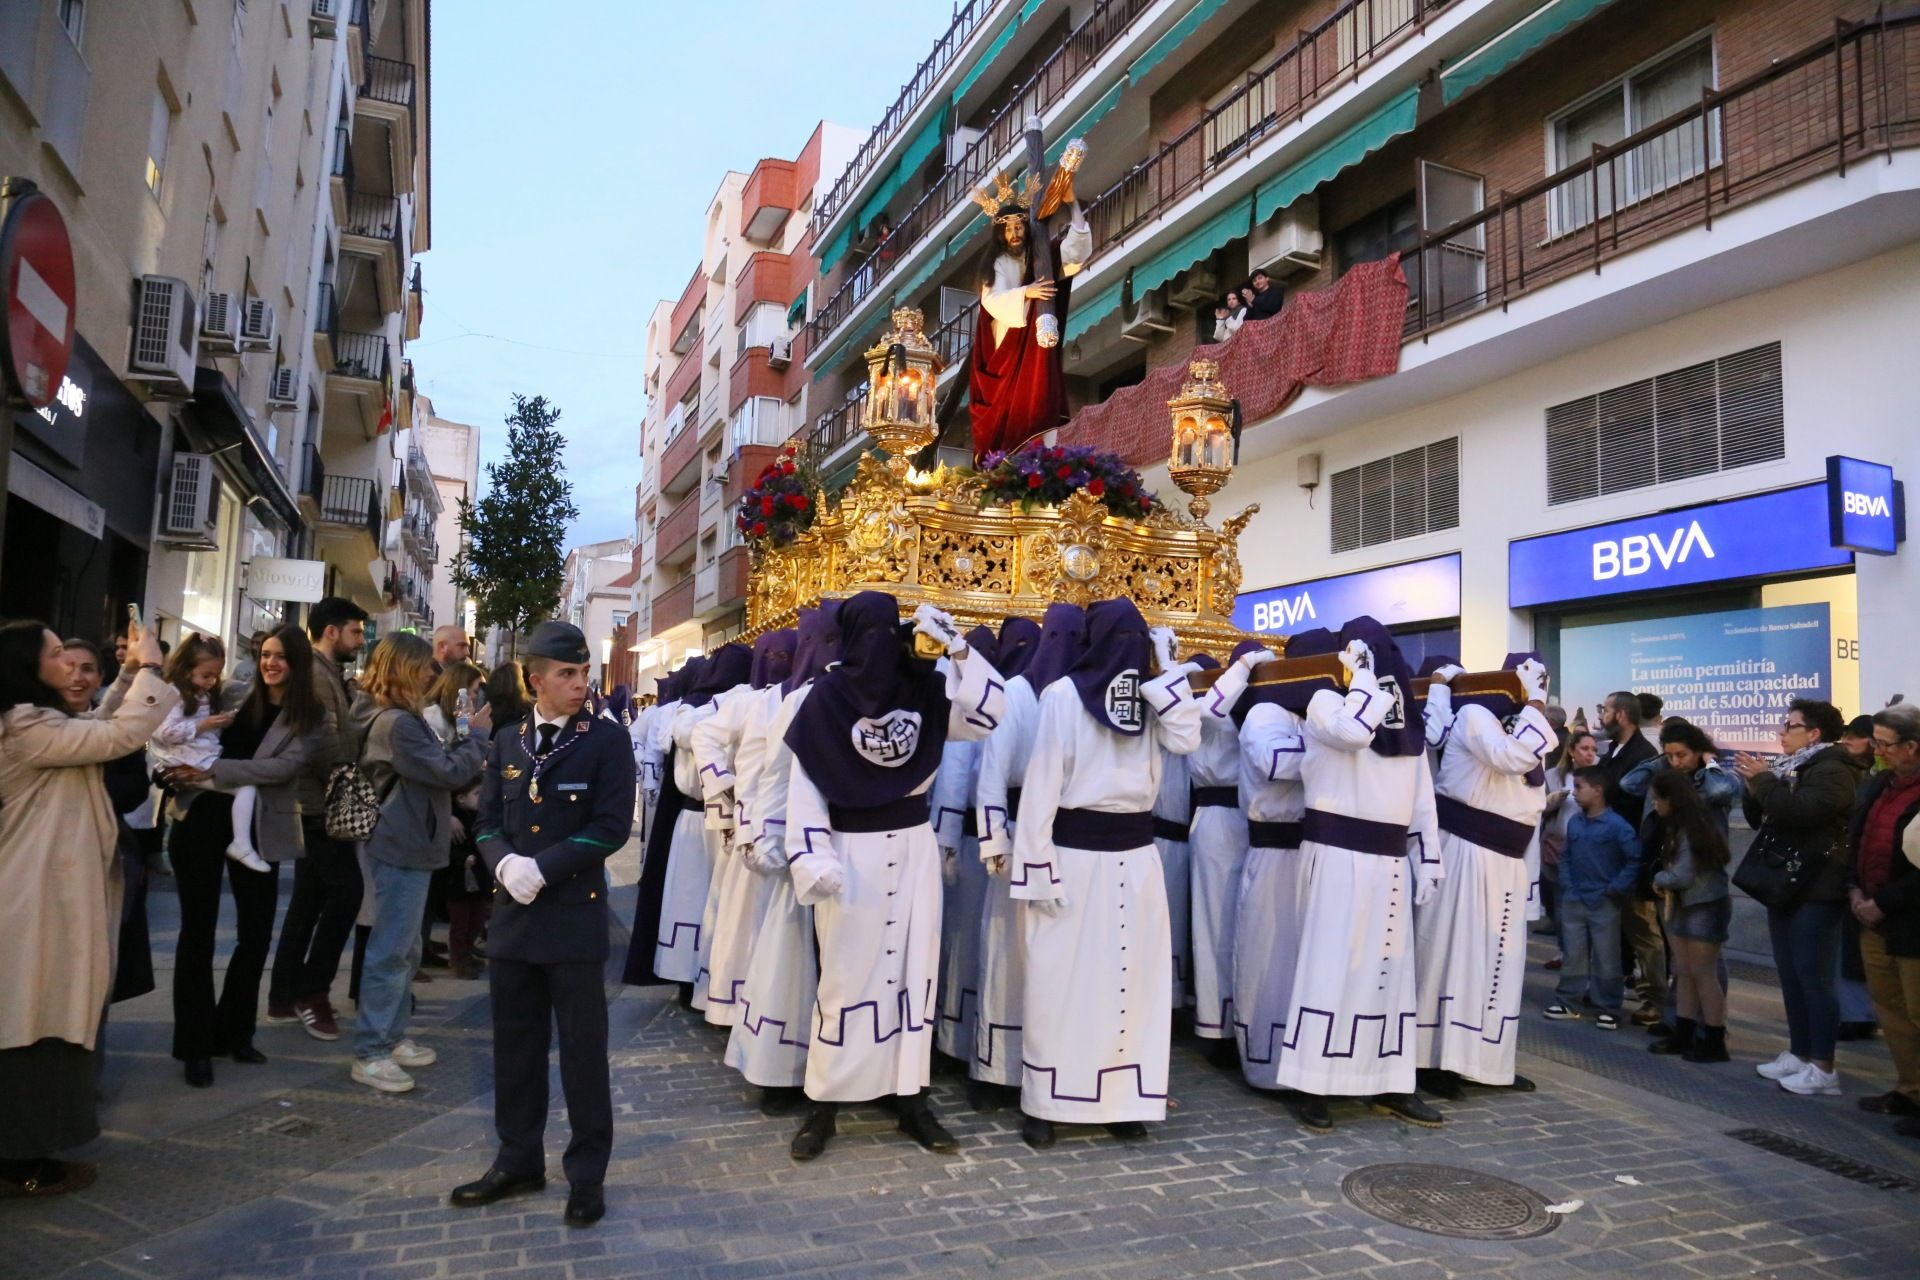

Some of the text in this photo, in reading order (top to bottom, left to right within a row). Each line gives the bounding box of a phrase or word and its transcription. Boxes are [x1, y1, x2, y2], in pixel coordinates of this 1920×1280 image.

[1844, 491, 1890, 517] BBVA
[1592, 520, 1715, 581] BBVA
[1253, 591, 1317, 632] BBVA
[1769, 623, 1790, 631] Banco
[1631, 667, 1649, 682] La
[1651, 664, 1694, 680] unión
[1695, 658, 1776, 681] permitiría
[1677, 682, 1704, 695] con
[1706, 680, 1735, 693] una
[1736, 672, 1820, 695] capacidad
[1660, 695, 1696, 711] onal
[1699, 694, 1718, 710] de
[1719, 692, 1764, 709] 5.000
[1711, 709, 1783, 726] financiar
[1713, 727, 1777, 742] familias
